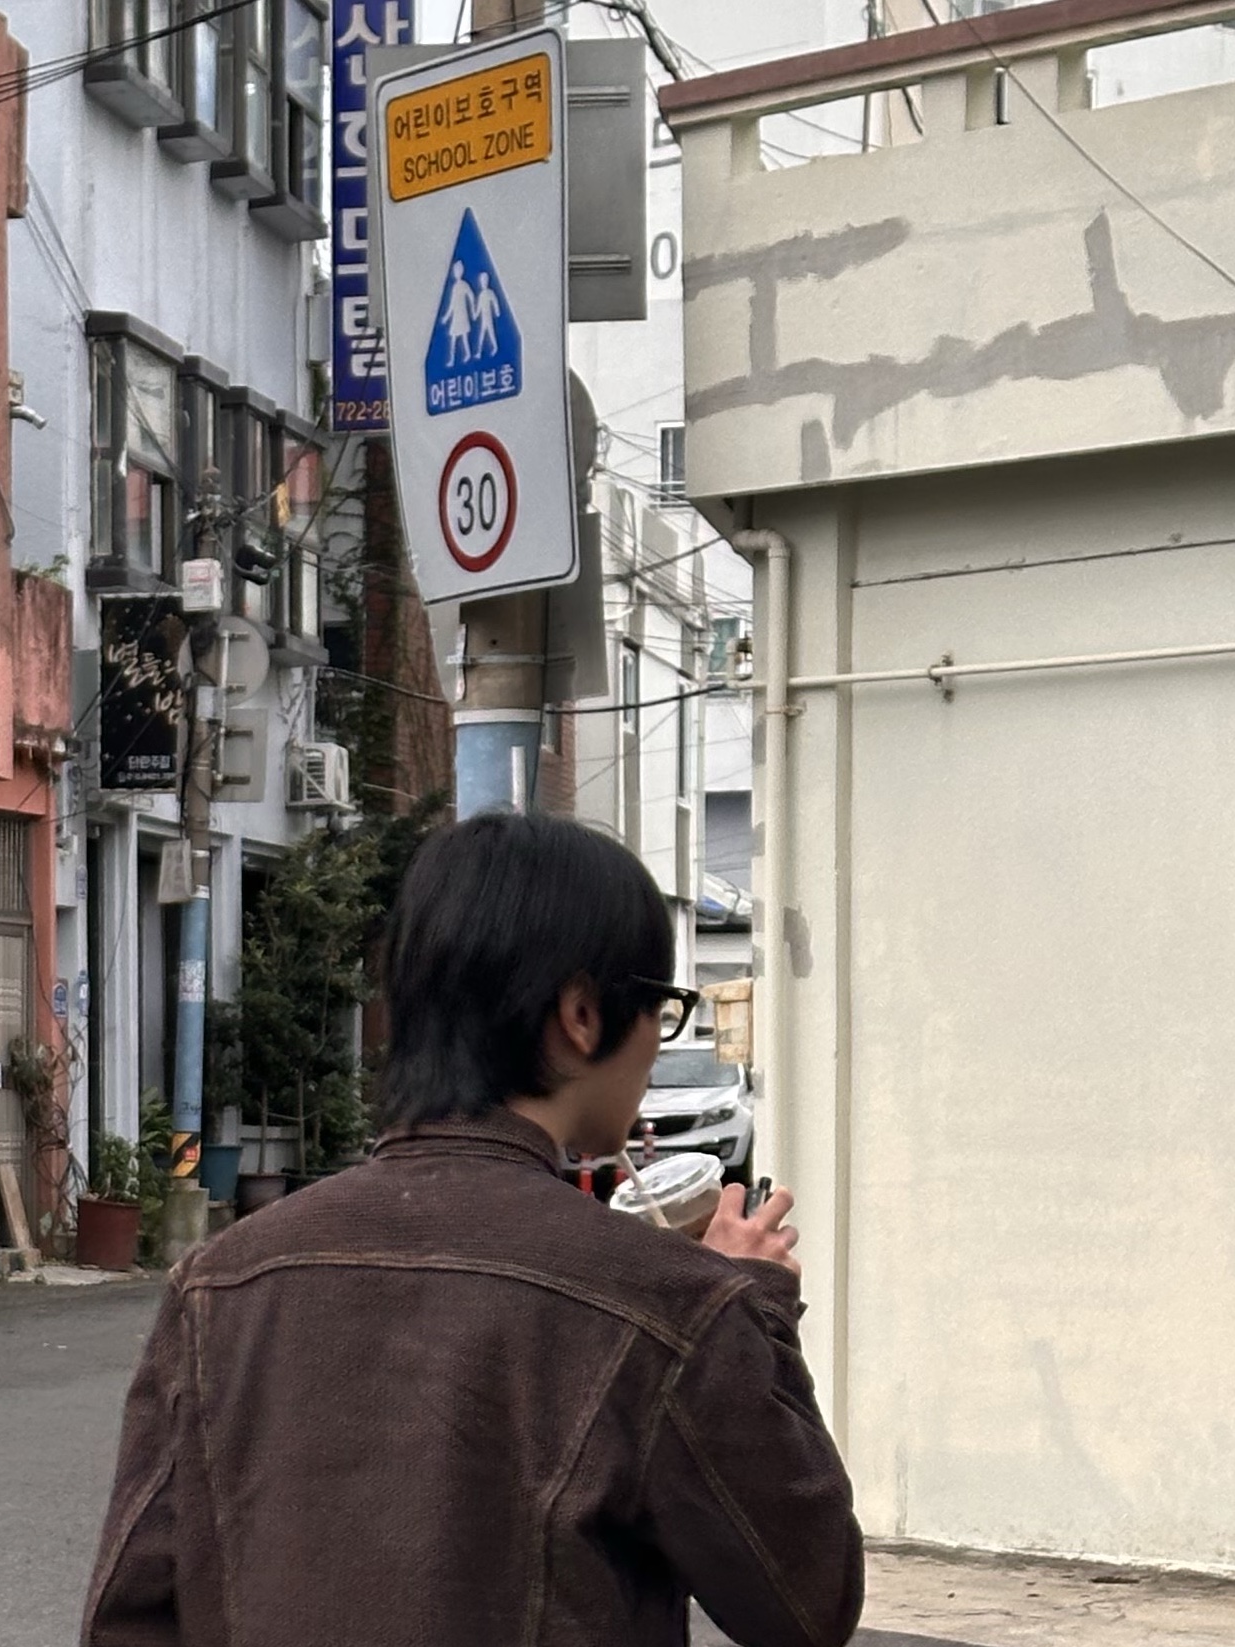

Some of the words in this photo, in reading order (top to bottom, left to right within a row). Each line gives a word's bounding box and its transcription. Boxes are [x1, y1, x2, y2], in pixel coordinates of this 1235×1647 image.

[394, 69, 543, 141] 어린이보호구역
[403, 141, 478, 183] SCHOOL
[483, 121, 535, 161] ZONE
[430, 363, 516, 408] 어린이보호
[457, 472, 497, 536] 30
